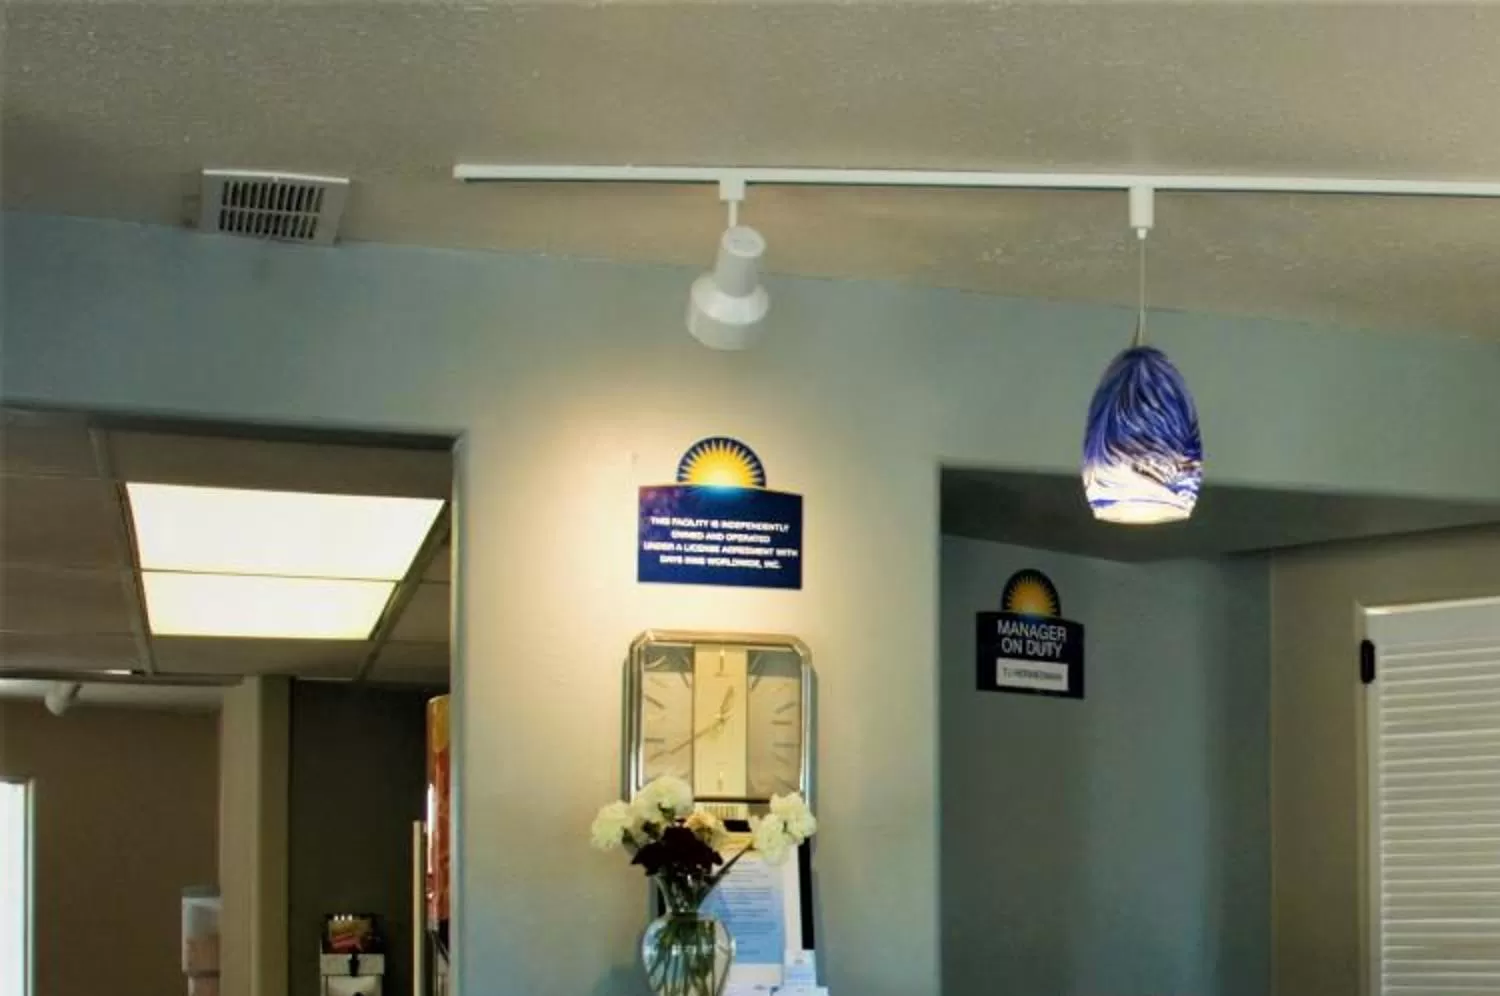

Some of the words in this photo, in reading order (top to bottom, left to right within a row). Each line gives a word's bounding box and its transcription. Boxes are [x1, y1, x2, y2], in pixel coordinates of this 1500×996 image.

[672, 517, 708, 529] FACILITY
[706, 532, 725, 542] AND
[727, 533, 771, 544] OPERATED
[997, 619, 1067, 641] MANAGER
[1001, 637, 1022, 655] ON
[1026, 640, 1063, 658] DUTY
